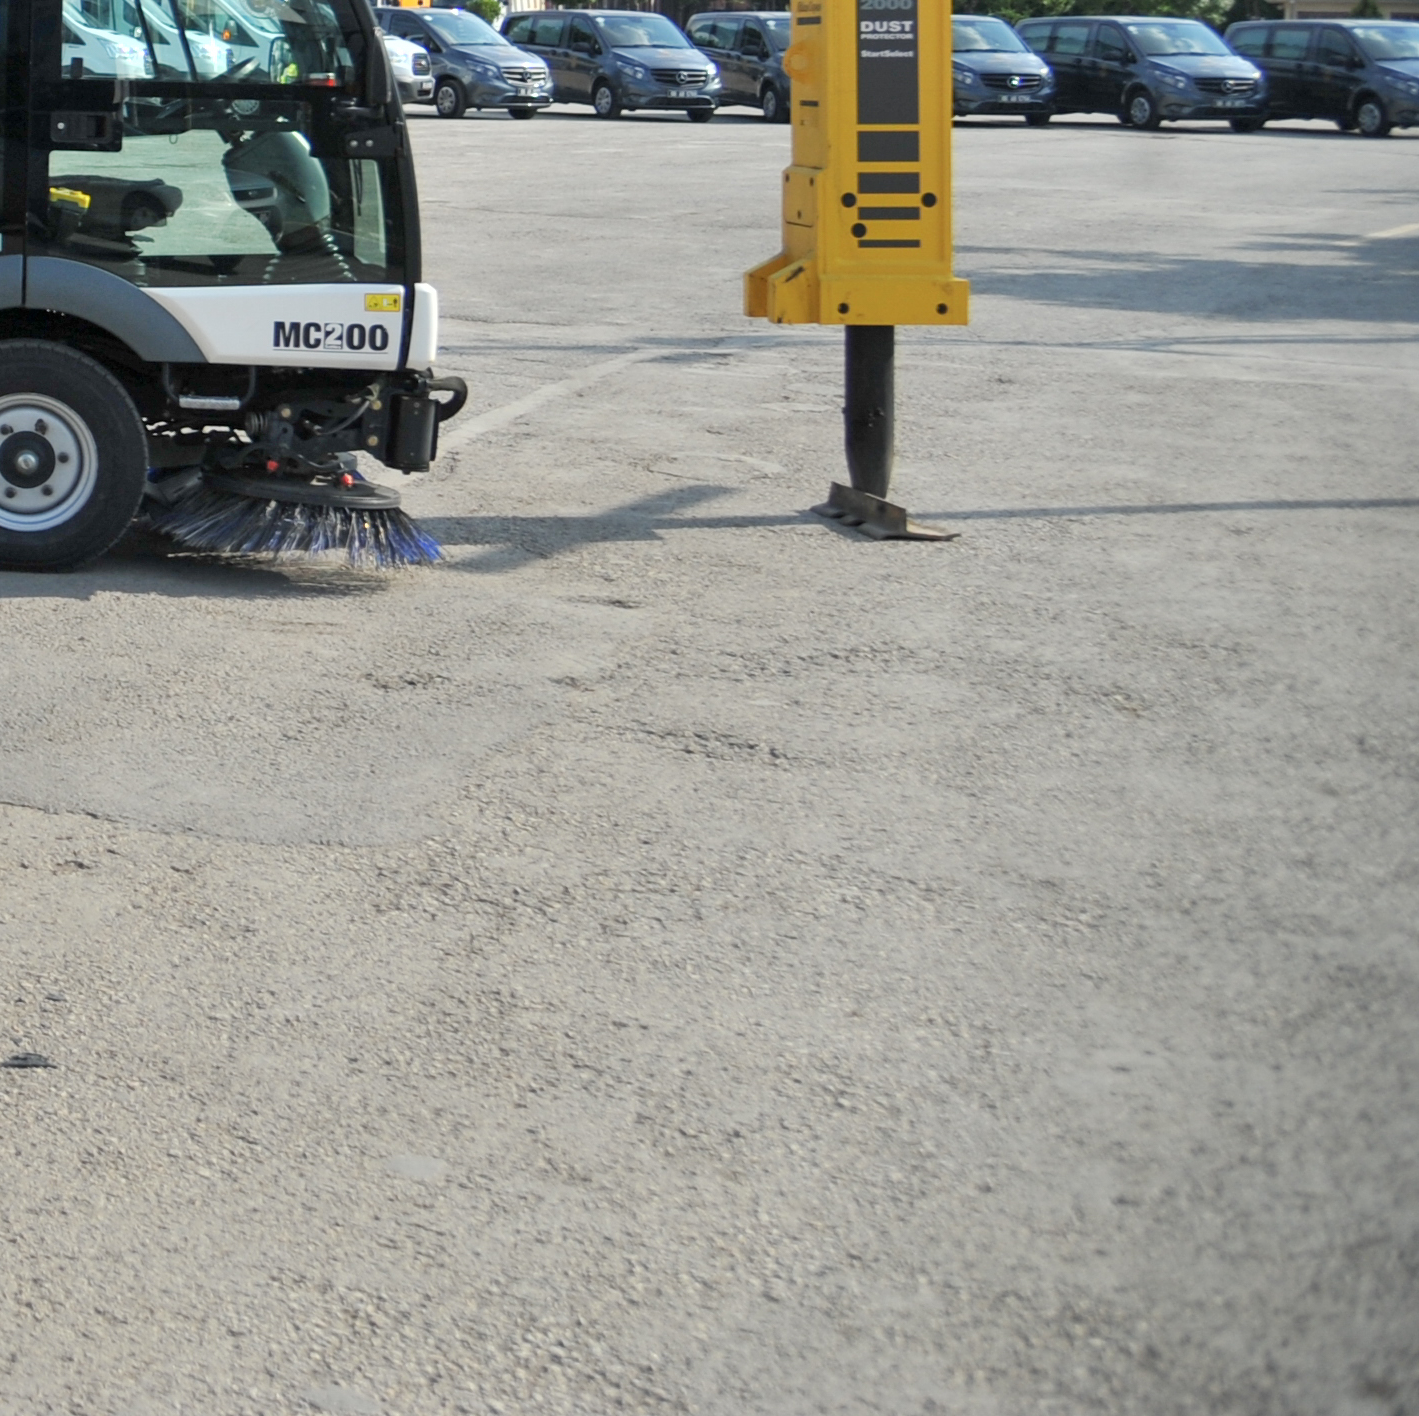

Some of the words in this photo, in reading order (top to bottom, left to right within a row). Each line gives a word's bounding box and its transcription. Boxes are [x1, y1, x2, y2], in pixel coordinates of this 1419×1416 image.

[860, 20, 914, 32] DUST
[860, 49, 914, 58] StartSelect
[273, 320, 390, 351] MC200
